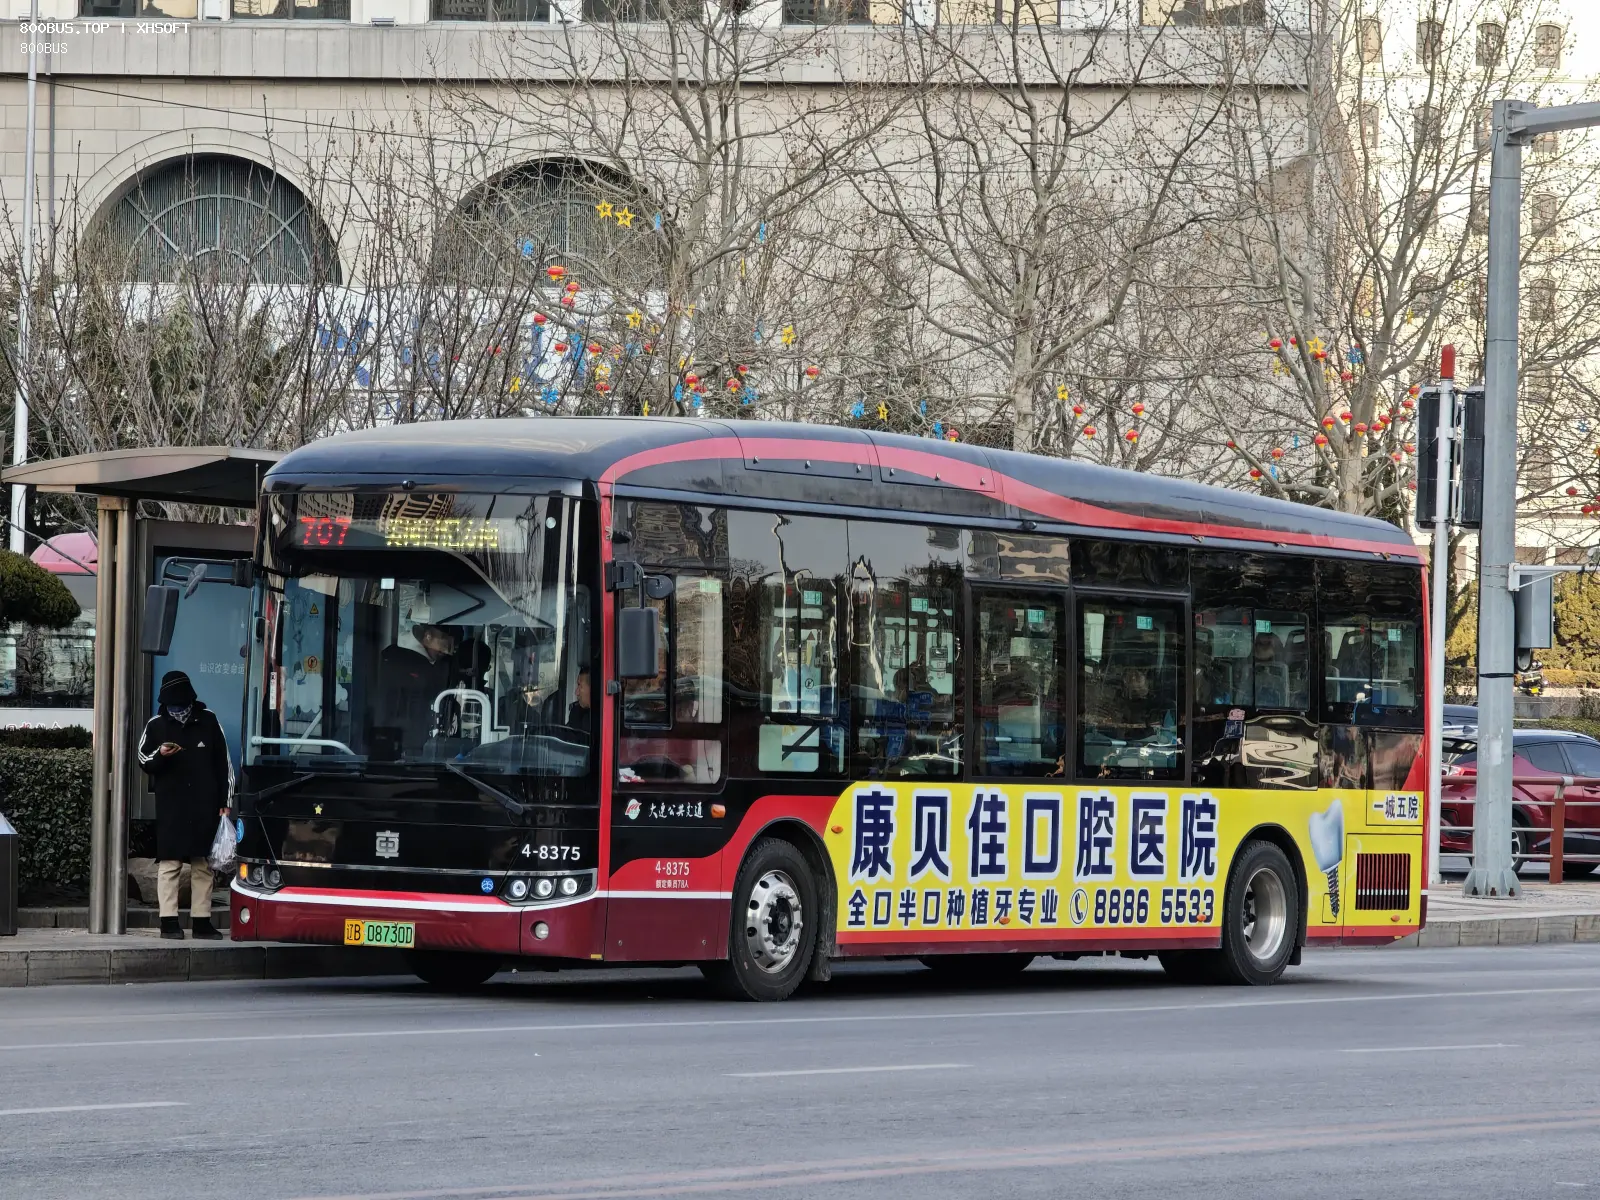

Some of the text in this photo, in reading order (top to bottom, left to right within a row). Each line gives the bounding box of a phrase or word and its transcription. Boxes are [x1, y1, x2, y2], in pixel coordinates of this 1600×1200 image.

[300, 516, 350, 546] 707
[1373, 794, 1419, 819] 一城五院
[851, 789, 1216, 879] 康贝佳口腔医院
[520, 842, 582, 862] 4-8375
[655, 860, 690, 876] 4-8375
[847, 888, 1216, 927] 全口半口种植牙专业 8886 5533
